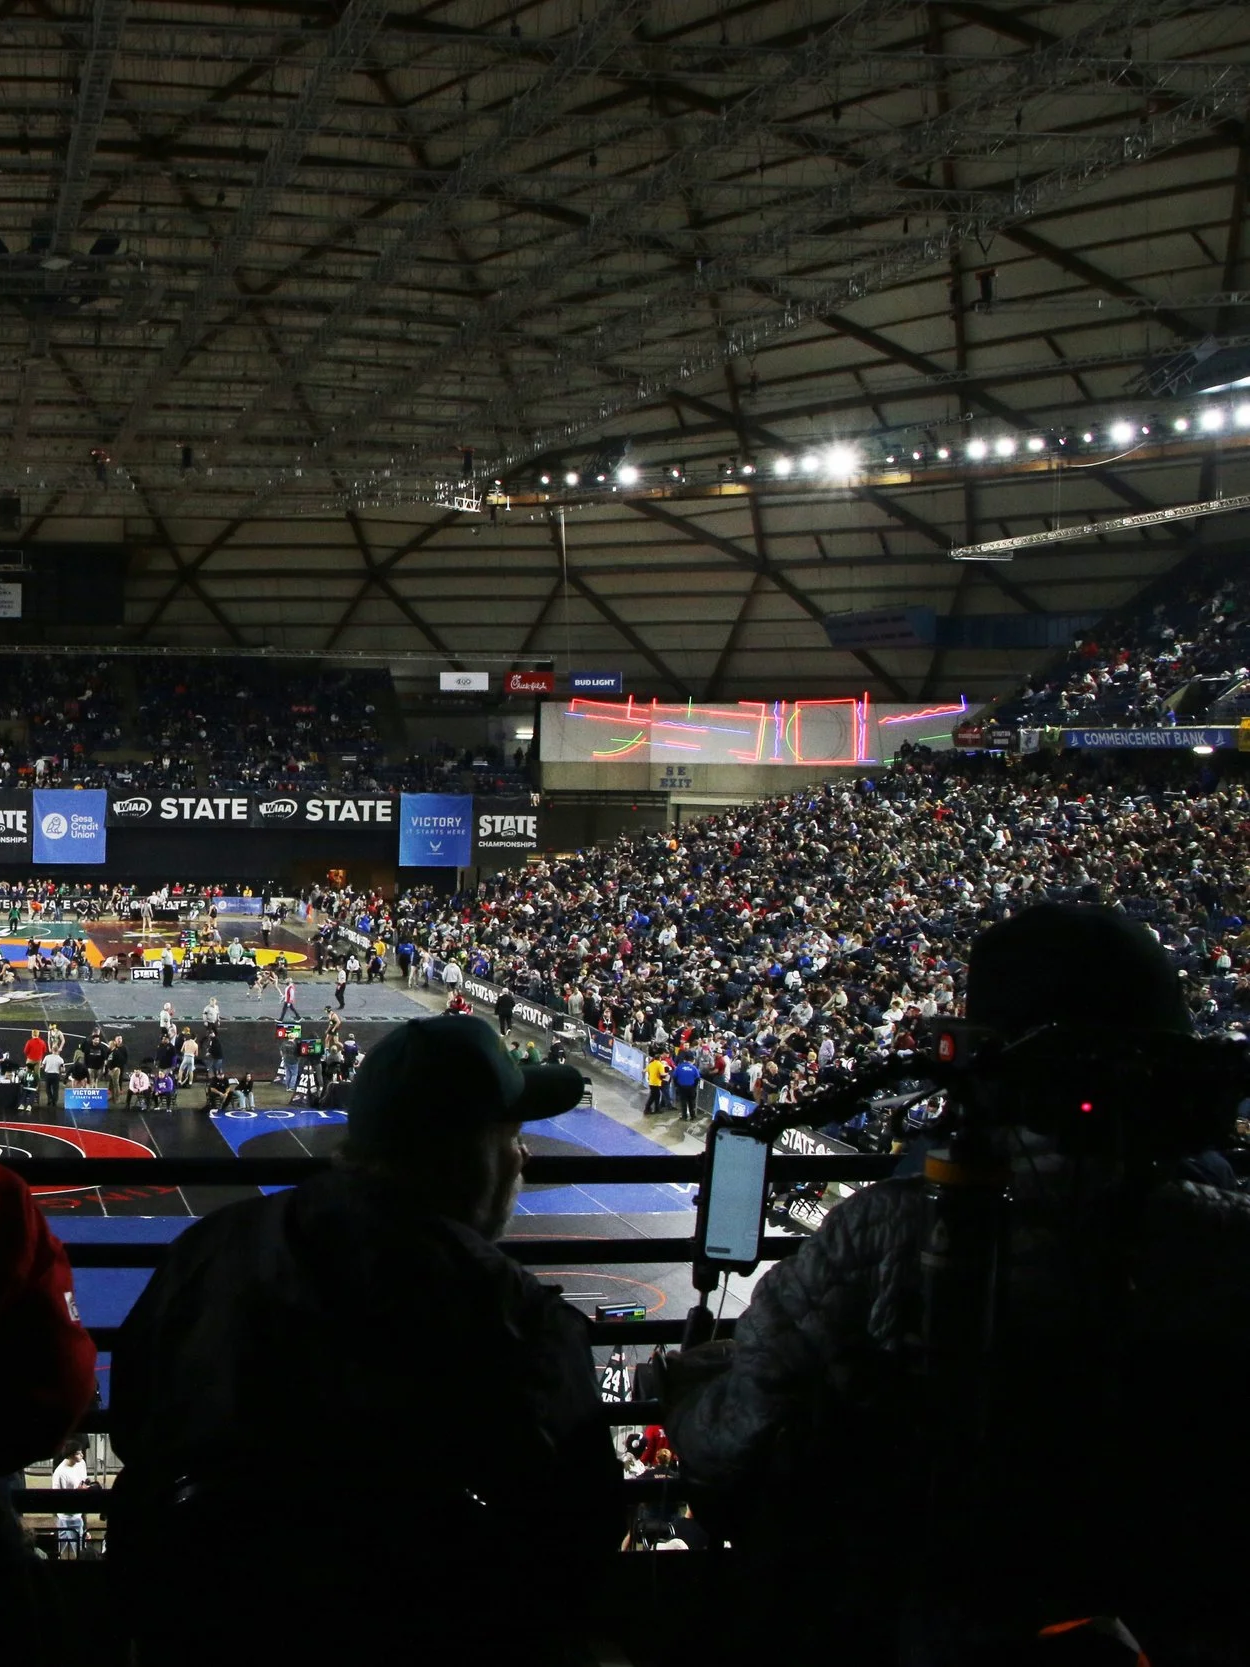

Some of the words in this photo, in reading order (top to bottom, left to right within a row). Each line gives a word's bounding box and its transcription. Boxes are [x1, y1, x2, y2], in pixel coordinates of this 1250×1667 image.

[1084, 732, 1171, 745] COMMENCEMENT
[1174, 732, 1206, 745] BANK
[660, 778, 692, 788] EXIT
[160, 798, 247, 820] STATE
[305, 799, 391, 822] STATE
[71, 814, 93, 823] Gesa
[412, 816, 462, 827] VICTORY
[71, 822, 98, 831] Credit
[479, 815, 537, 838] STATE
[71, 830, 95, 839] Union
[133, 969, 160, 979] STATE
[781, 1128, 816, 1155] STATE
[602, 1367, 620, 1392] 24
